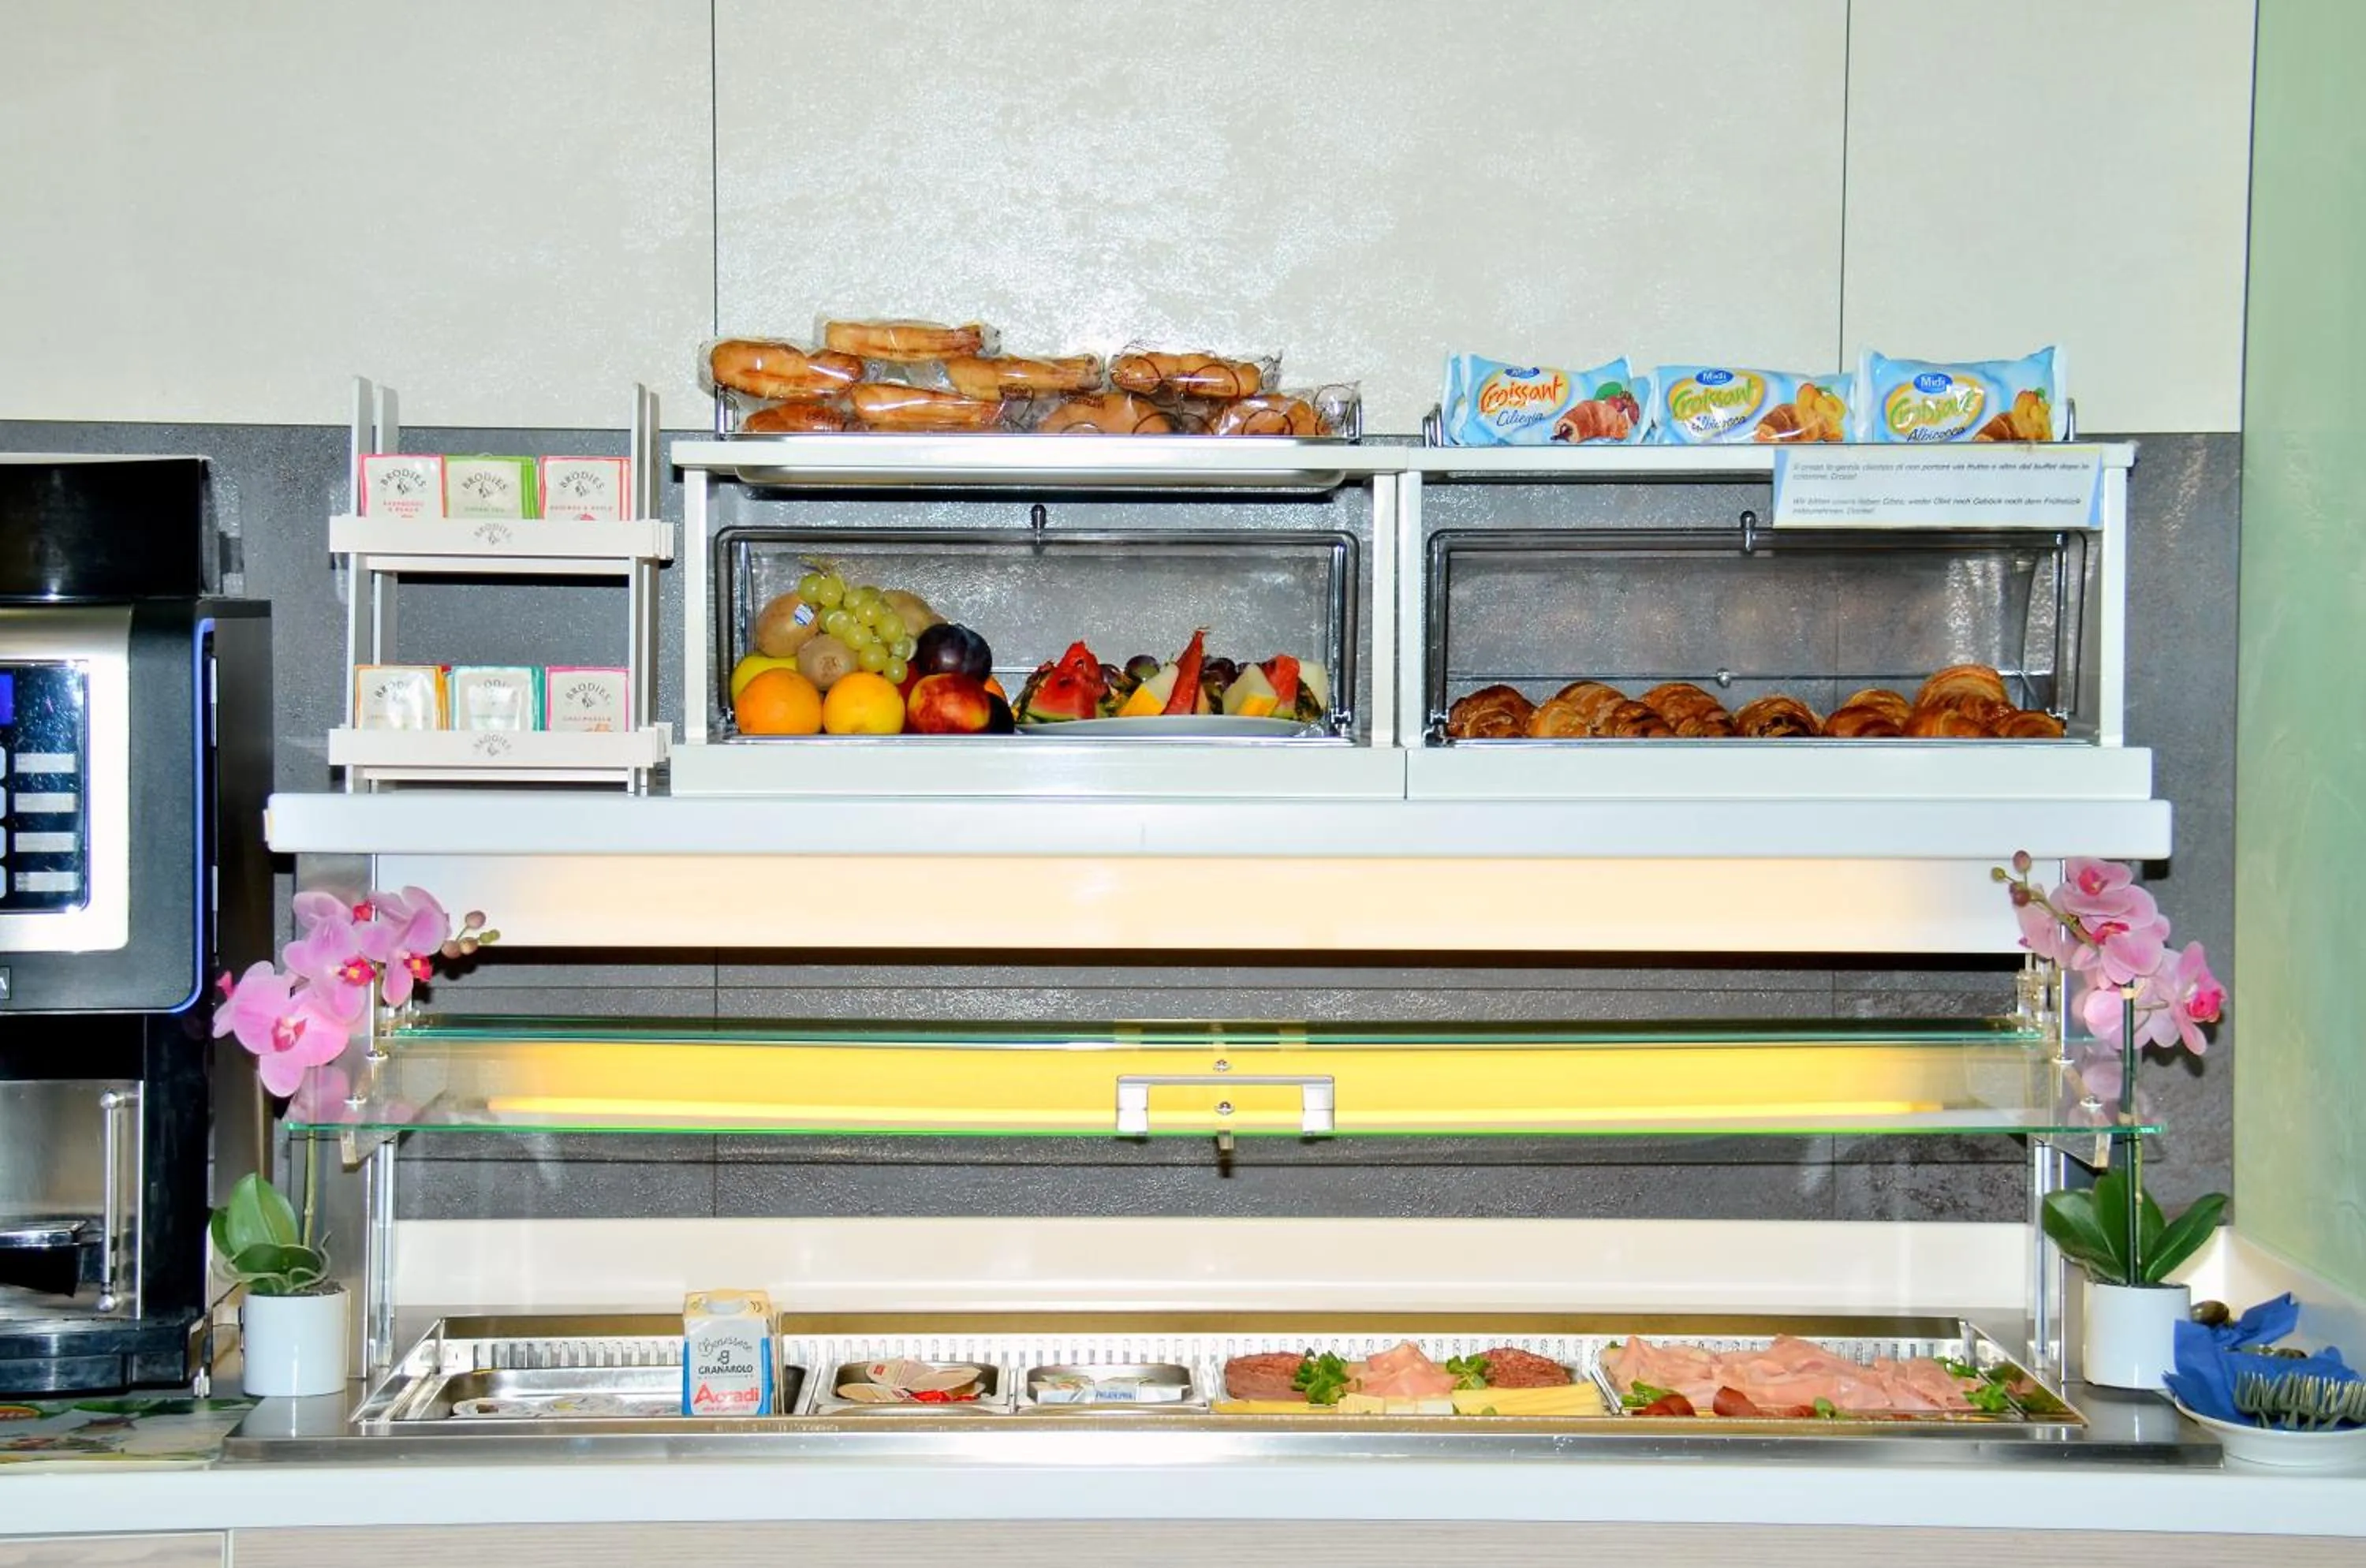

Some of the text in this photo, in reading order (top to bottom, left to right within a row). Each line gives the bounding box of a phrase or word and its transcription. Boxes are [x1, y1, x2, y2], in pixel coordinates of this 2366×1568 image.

[1920, 375, 1946, 387] Midi
[380, 468, 427, 487] BRODIES
[461, 472, 509, 490] BRODIES
[559, 471, 605, 489] BRODIES
[565, 682, 612, 702] BRODIES
[698, 1365, 753, 1375] GRANAROLO
